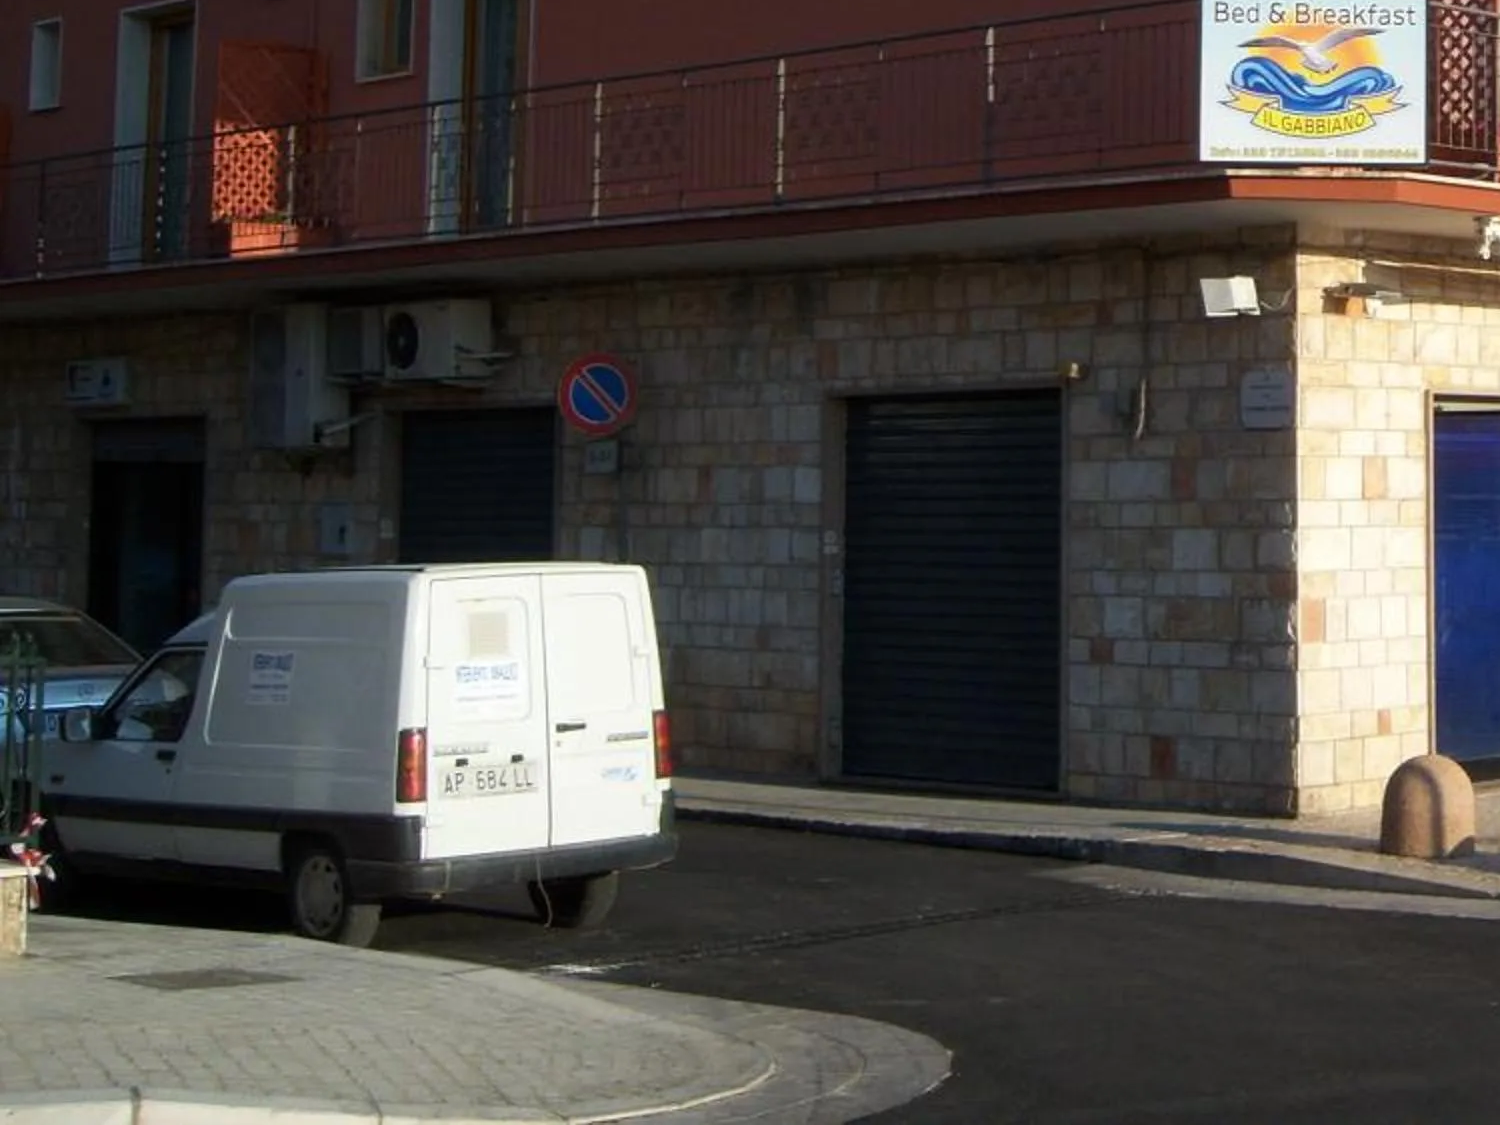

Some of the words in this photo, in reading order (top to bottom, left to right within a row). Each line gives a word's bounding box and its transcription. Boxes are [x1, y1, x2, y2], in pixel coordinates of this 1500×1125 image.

[1213, 1, 1260, 23] Bed
[1269, 2, 1286, 22] &
[1295, 3, 1416, 26] Breakfast
[1263, 111, 1278, 127] IL
[1281, 112, 1366, 134] GABBIANO
[444, 771, 465, 794] AP
[513, 766, 535, 787] LL
